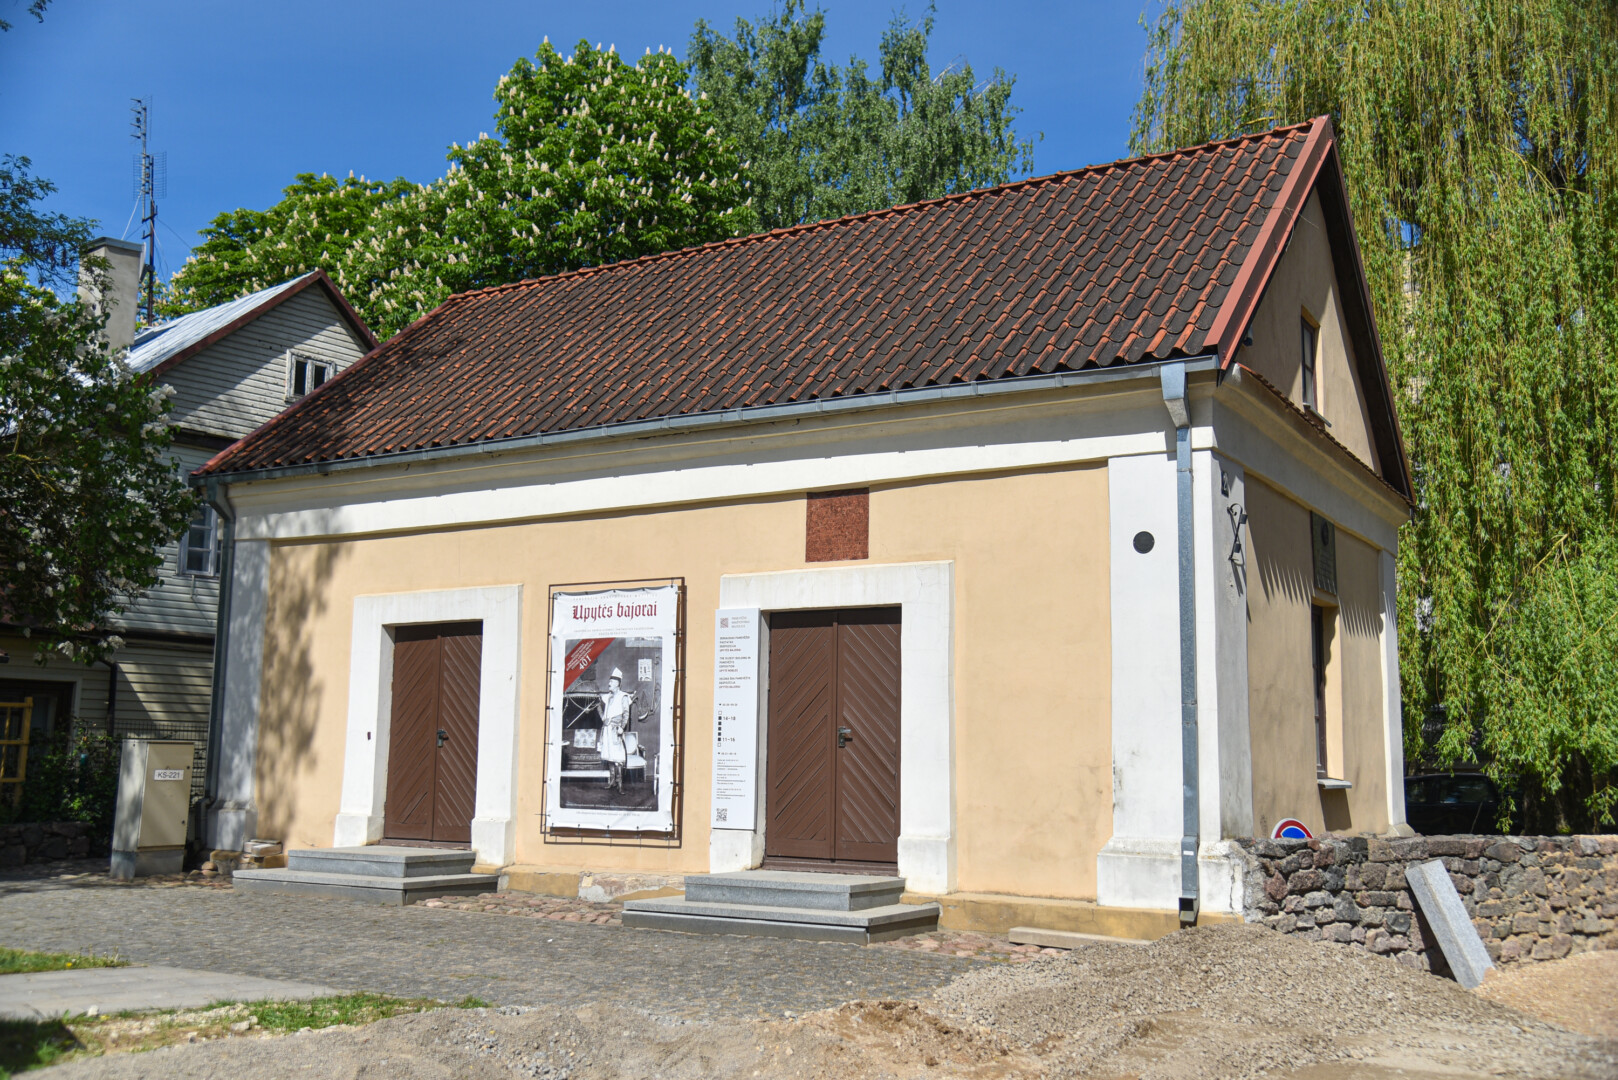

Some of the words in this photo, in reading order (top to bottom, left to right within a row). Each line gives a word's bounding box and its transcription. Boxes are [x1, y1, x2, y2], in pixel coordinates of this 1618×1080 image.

[572, 603, 613, 622] Upytės
[617, 600, 657, 620] bajorai
[579, 655, 592, 670] 401
